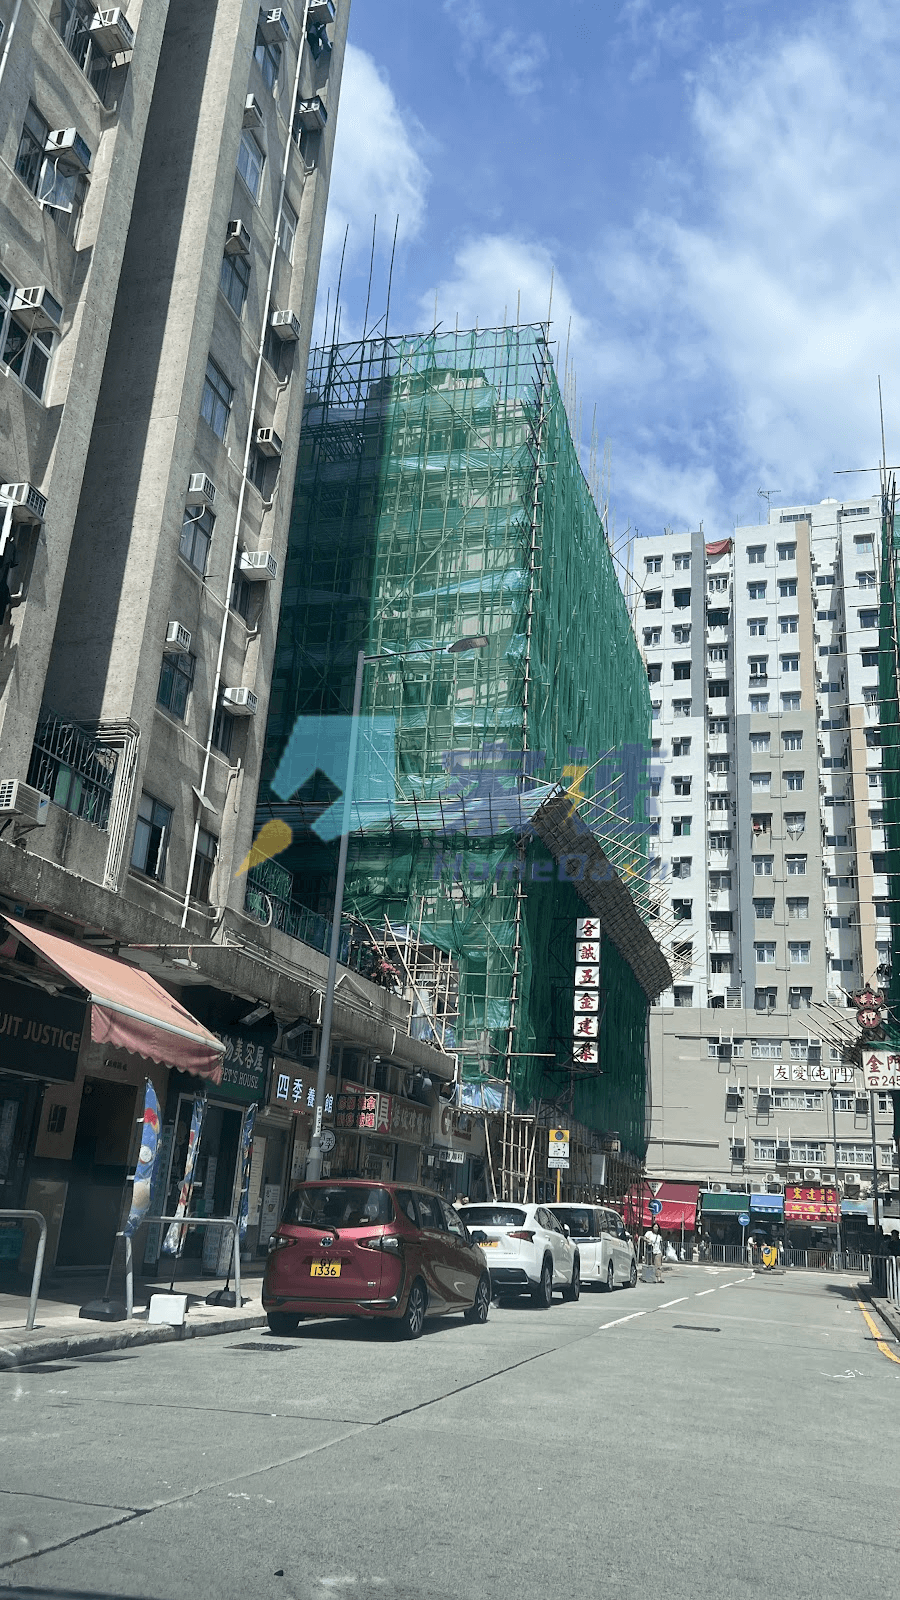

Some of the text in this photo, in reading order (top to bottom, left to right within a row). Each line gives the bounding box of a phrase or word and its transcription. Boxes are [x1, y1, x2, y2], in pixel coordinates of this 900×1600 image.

[577, 919, 599, 1062] 合誠五金建築
[23, 1020, 81, 1053] JUSTICE
[213, 1031, 265, 1073] 物美容屋
[239, 1070, 259, 1089] HOUSE
[314, 1266, 337, 1276] 1336
